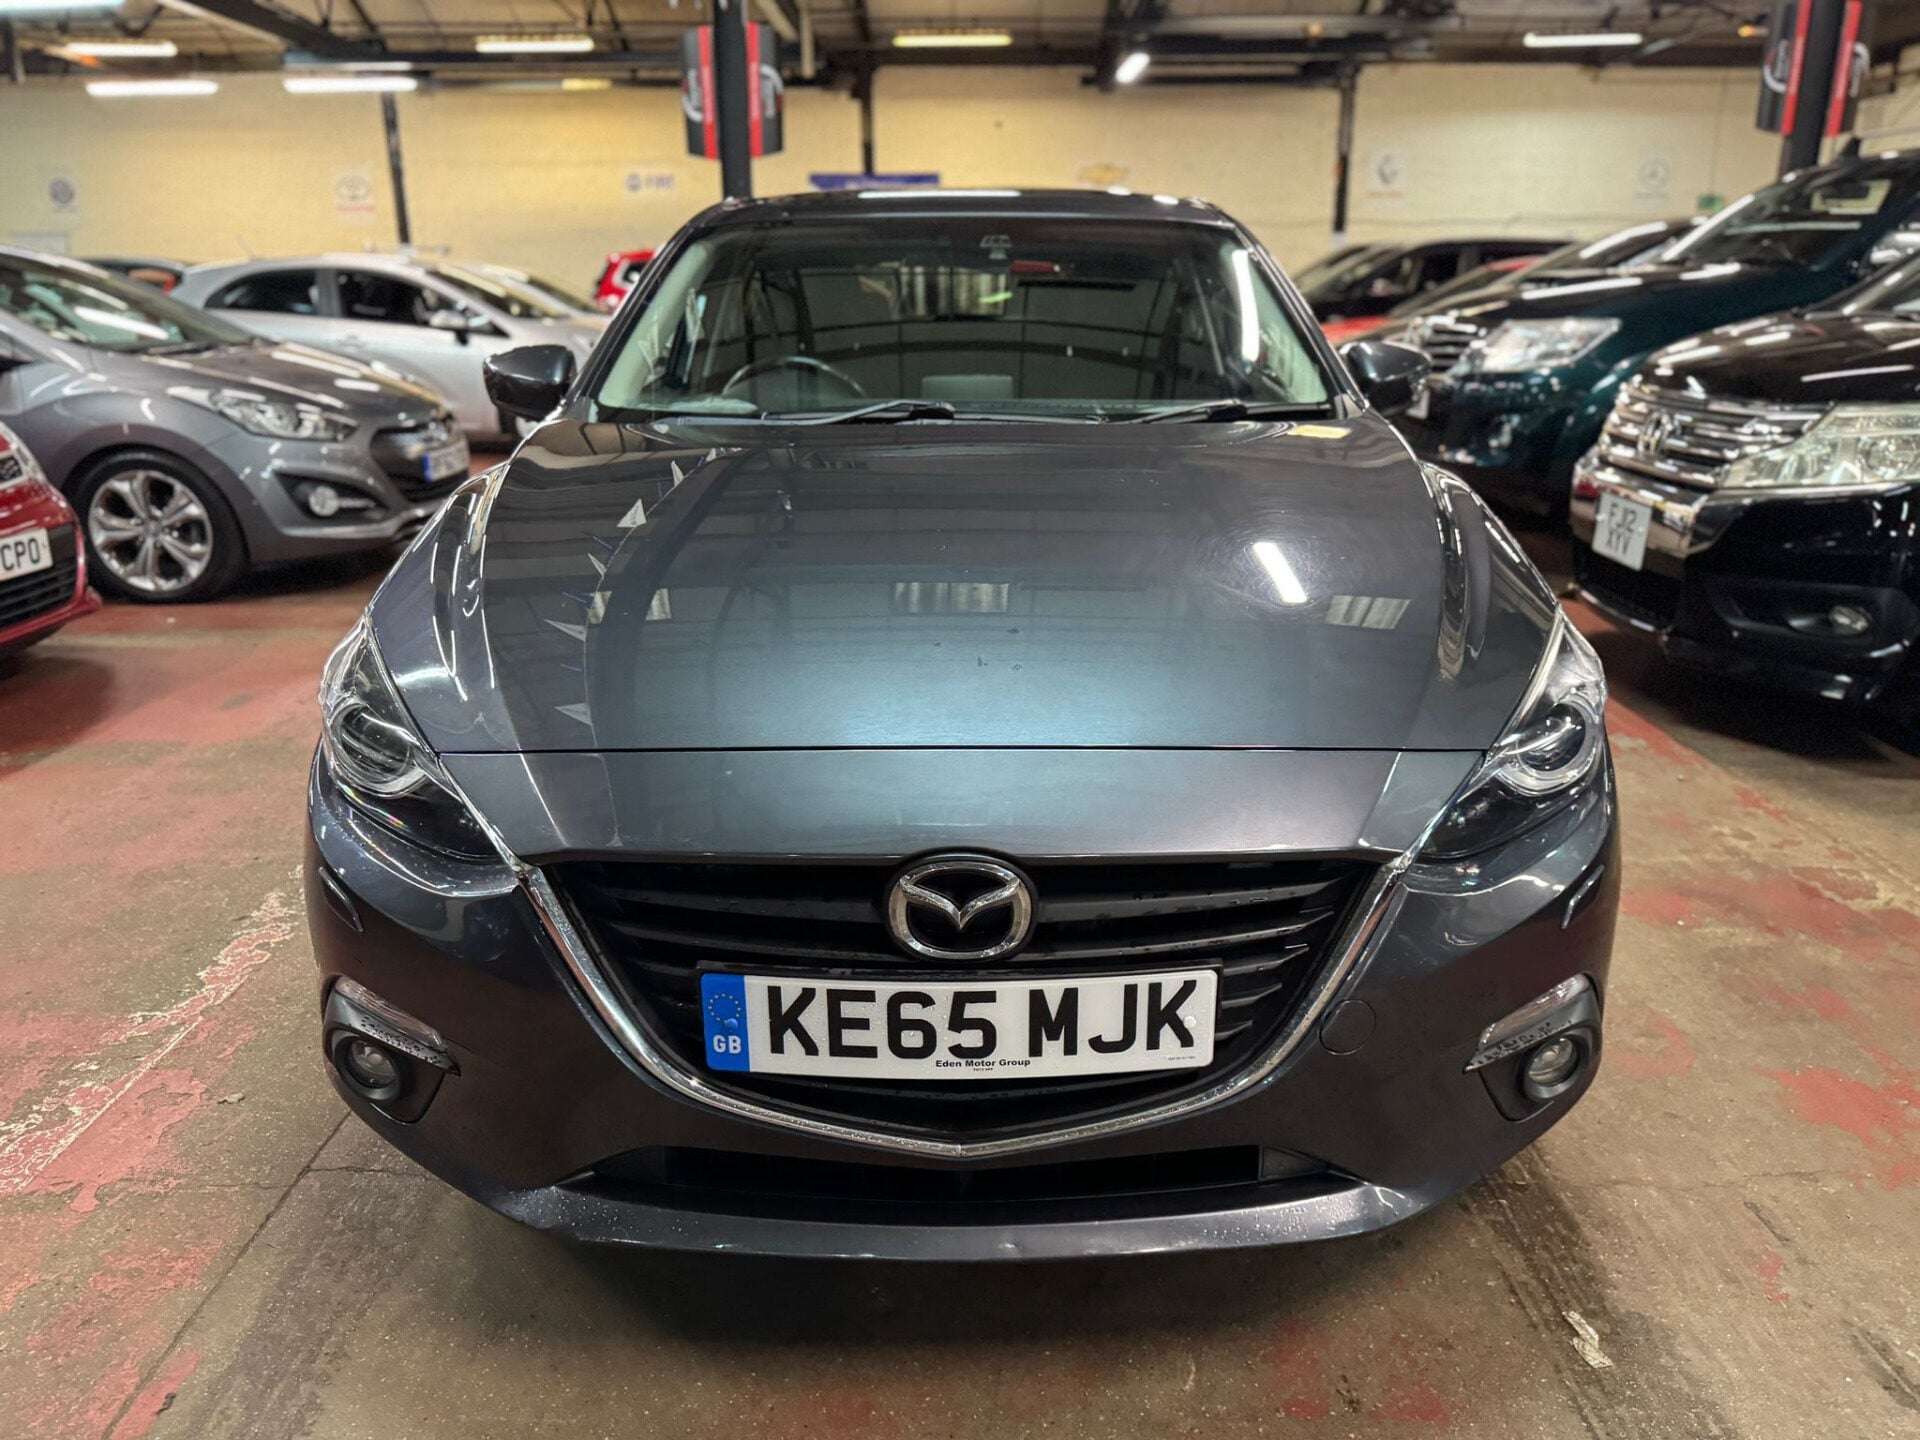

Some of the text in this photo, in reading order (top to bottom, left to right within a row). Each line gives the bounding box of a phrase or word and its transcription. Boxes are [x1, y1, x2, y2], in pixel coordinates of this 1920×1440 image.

[767, 979, 1197, 1059] KE65 MJK
[713, 1034, 742, 1054] GB
[935, 1058, 1031, 1068] Eden Motor Group
